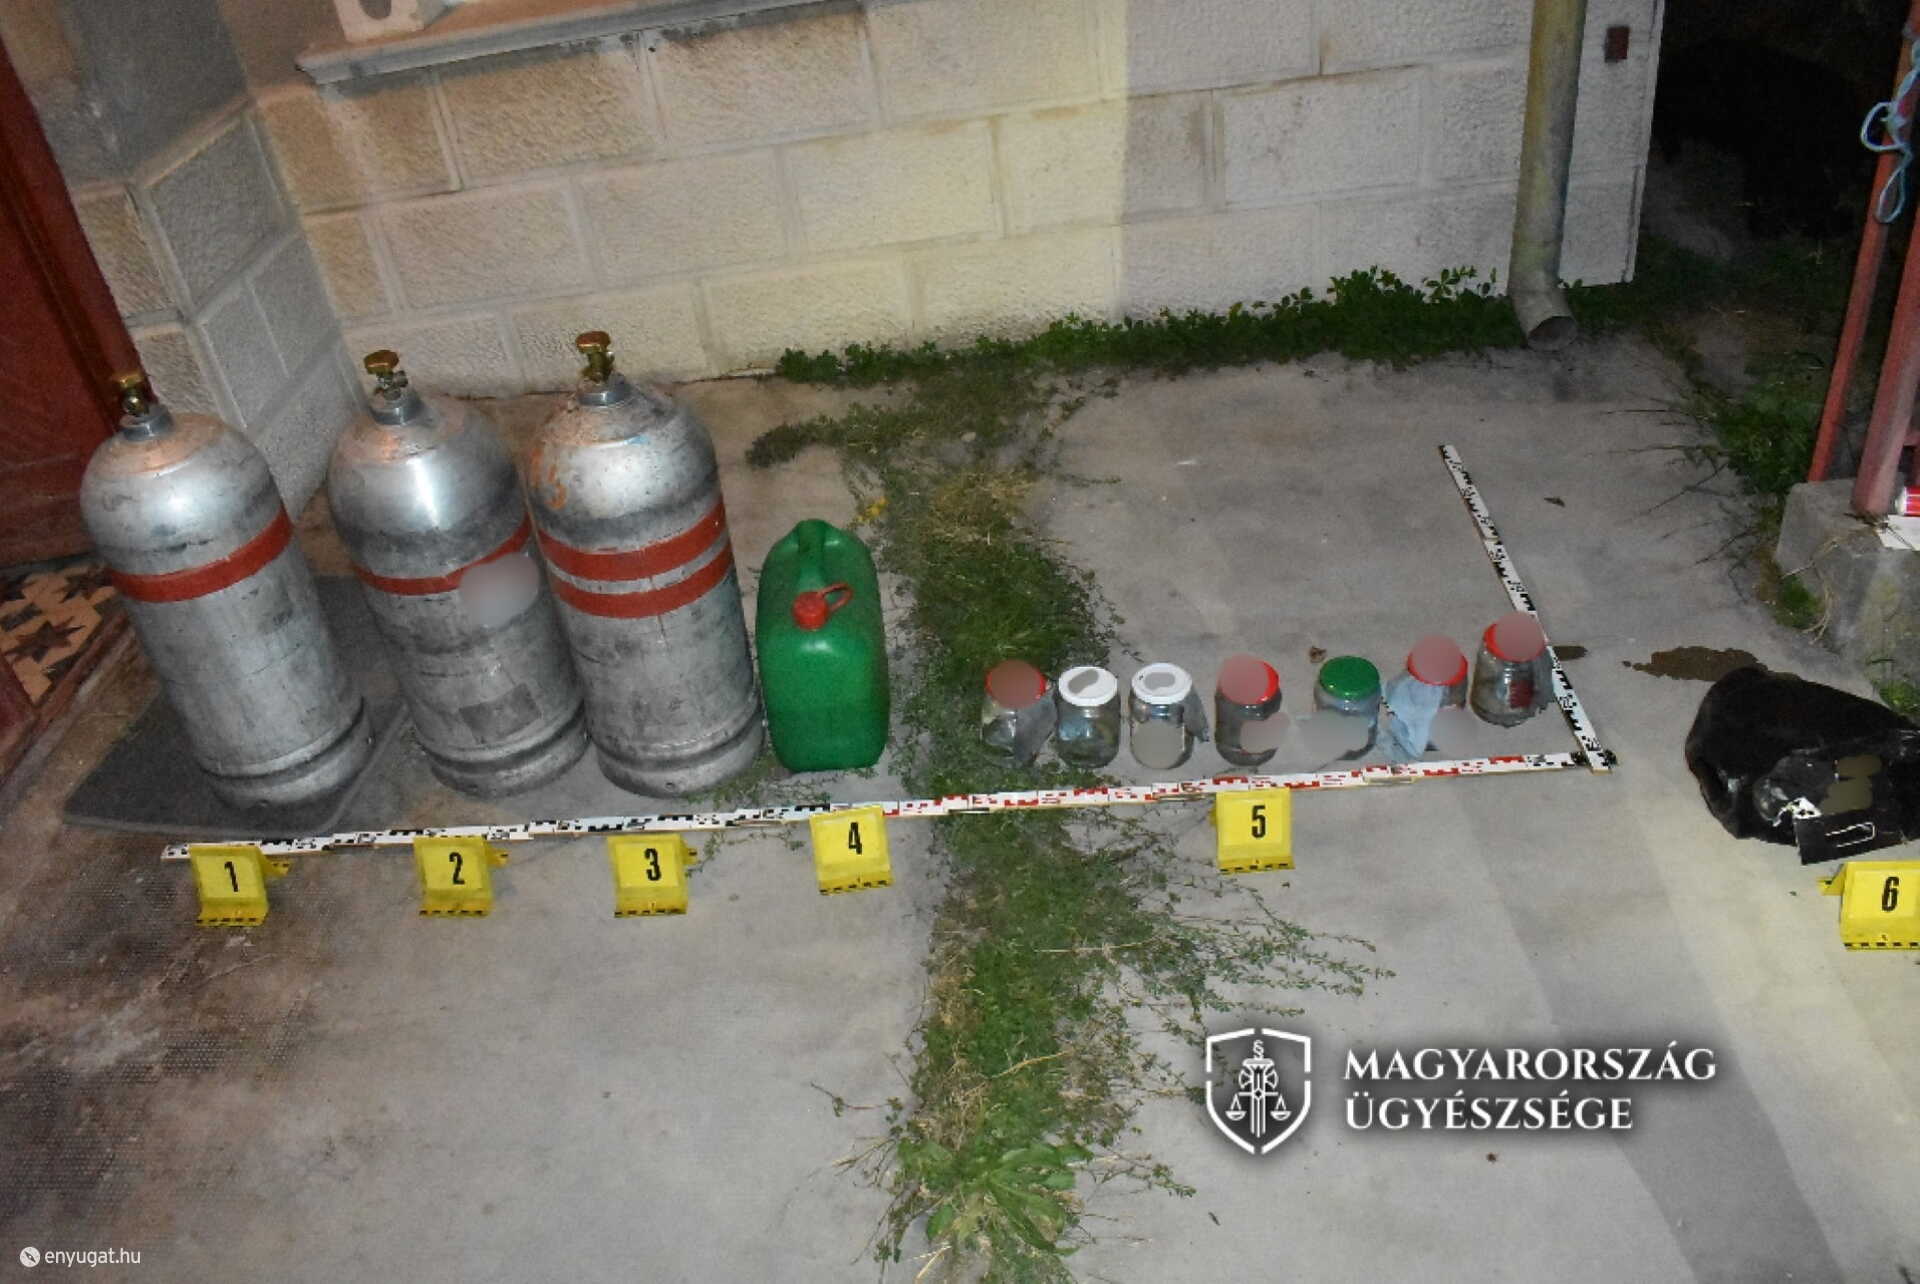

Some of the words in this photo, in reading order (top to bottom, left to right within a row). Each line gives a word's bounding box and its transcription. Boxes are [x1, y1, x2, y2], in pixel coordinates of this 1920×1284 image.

[848, 821, 863, 856] 4
[1251, 805, 1267, 839] 5
[223, 861, 239, 893] 1
[449, 851, 465, 885] 2
[644, 848, 662, 881] 3
[1881, 876, 1900, 913] 6
